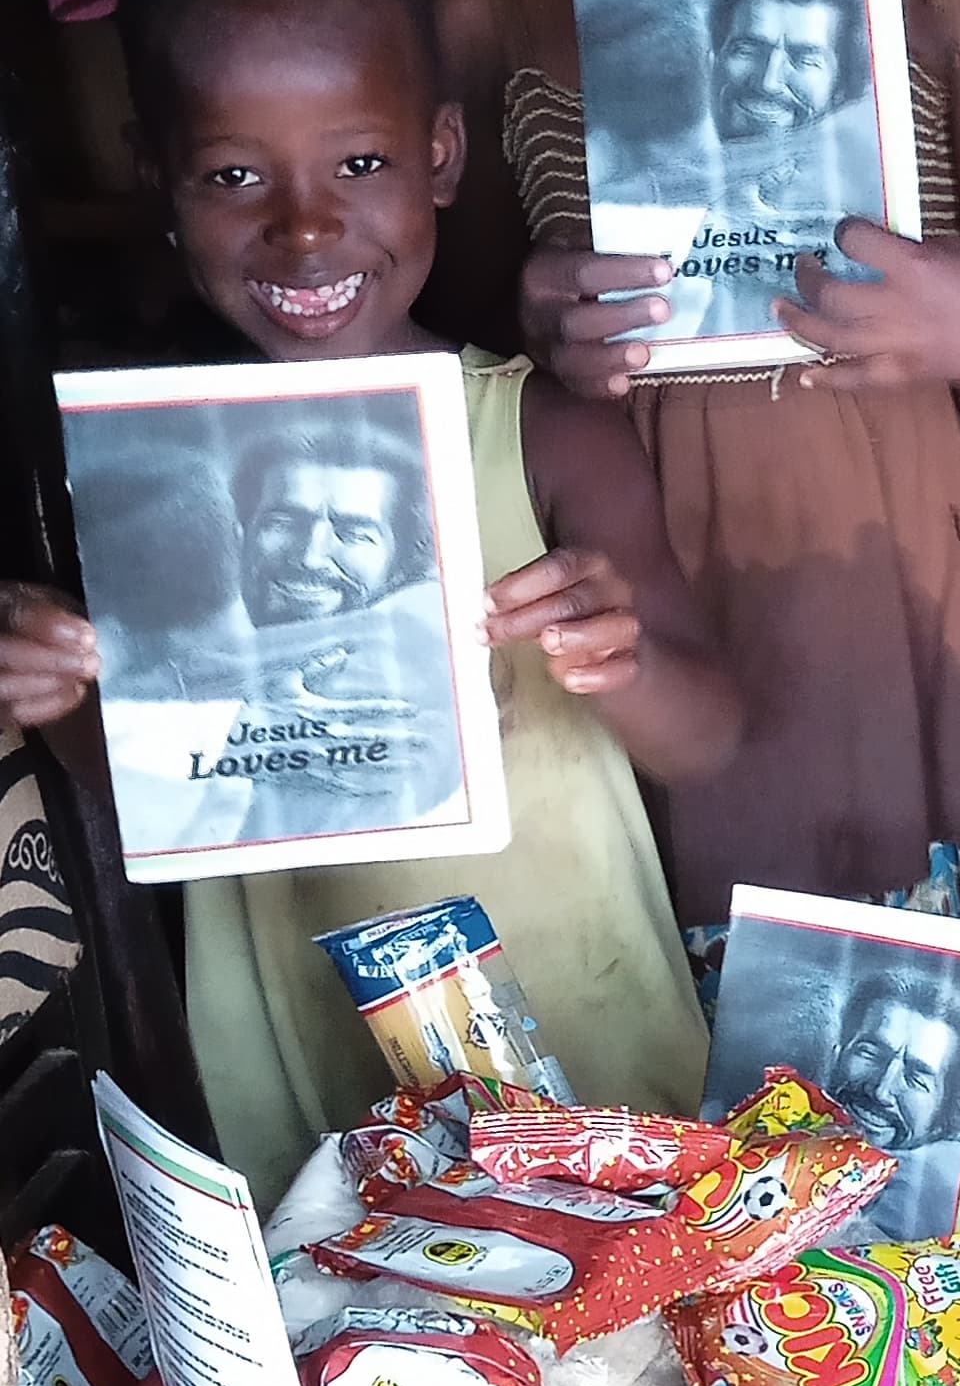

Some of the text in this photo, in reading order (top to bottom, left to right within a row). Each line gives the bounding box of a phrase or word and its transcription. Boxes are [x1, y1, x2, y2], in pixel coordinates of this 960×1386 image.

[692, 223, 777, 249] Jesus
[660, 250, 761, 278] oves
[226, 720, 328, 747] Jesus
[188, 741, 389, 780] Loves me
[916, 1264, 944, 1307] Free
[828, 1282, 871, 1336] SNACKS
